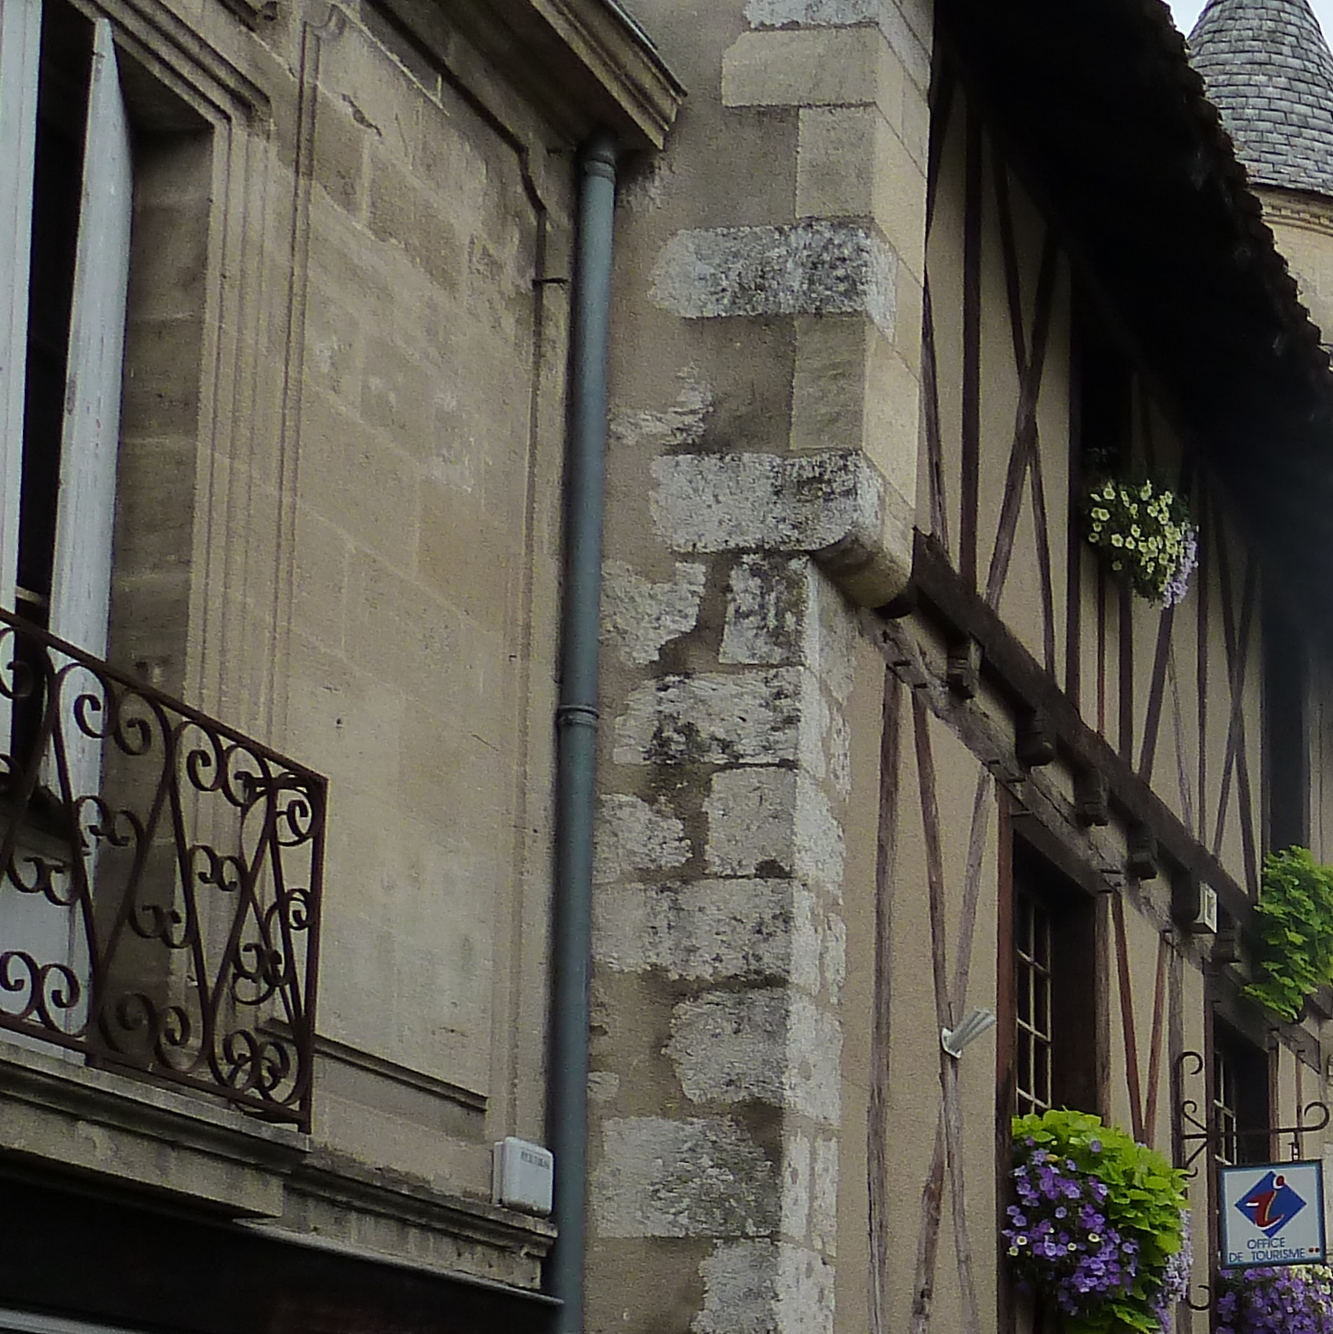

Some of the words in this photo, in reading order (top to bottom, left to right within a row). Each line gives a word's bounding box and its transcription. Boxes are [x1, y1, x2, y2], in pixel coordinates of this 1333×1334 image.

[1246, 1237, 1286, 1250] OFFICE
[1229, 1252, 1244, 1263] DE
[1251, 1248, 1306, 1261] TOURISME
